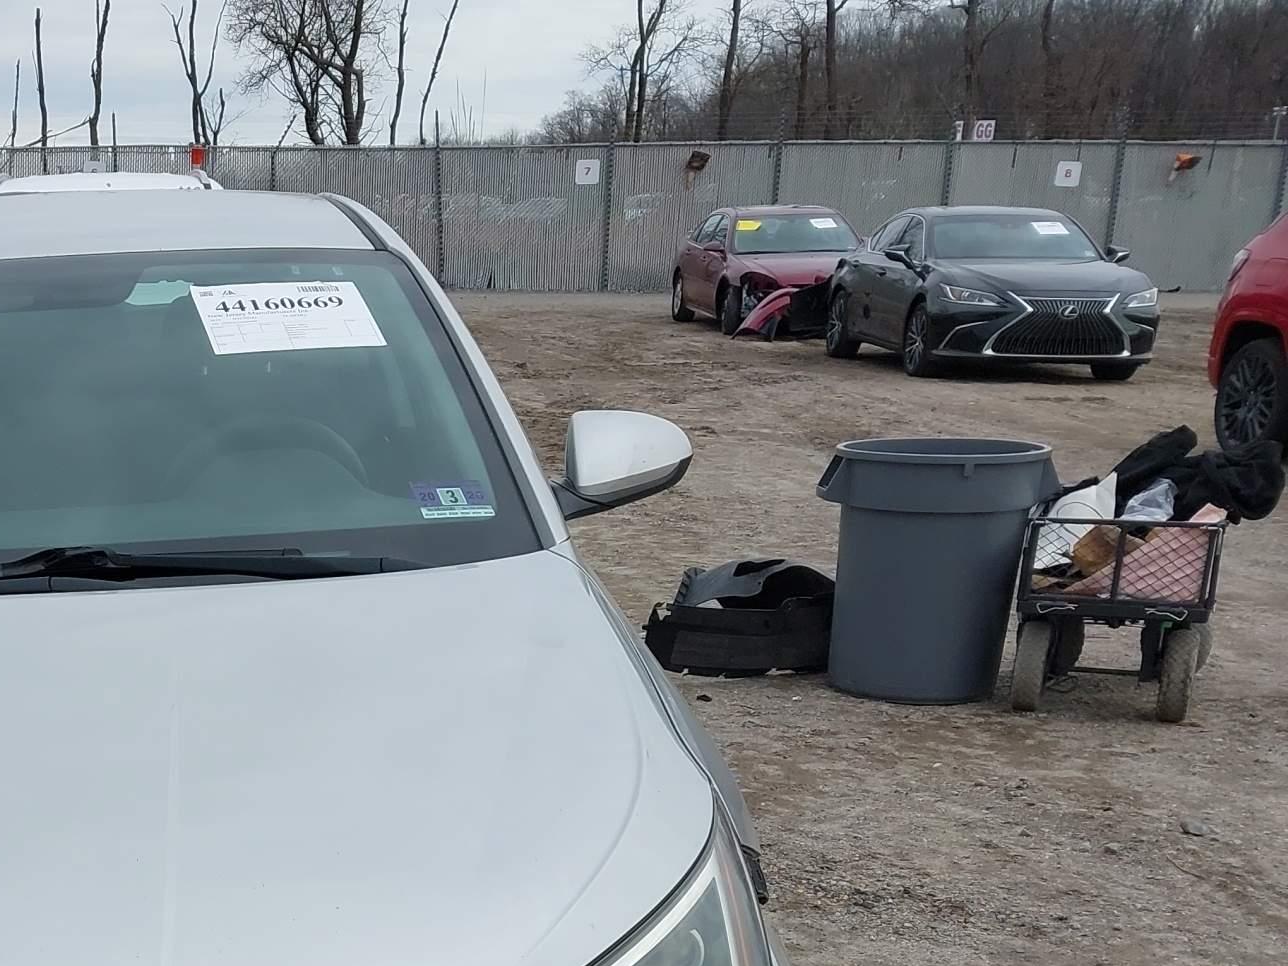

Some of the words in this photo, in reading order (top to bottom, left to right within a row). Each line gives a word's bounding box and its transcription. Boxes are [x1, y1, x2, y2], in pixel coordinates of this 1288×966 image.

[975, 122, 993, 139] GG
[583, 166, 592, 176] 7
[1064, 168, 1073, 178] 8
[215, 295, 344, 312] 44160669
[419, 491, 436, 502] 20
[446, 490, 459, 503] 3
